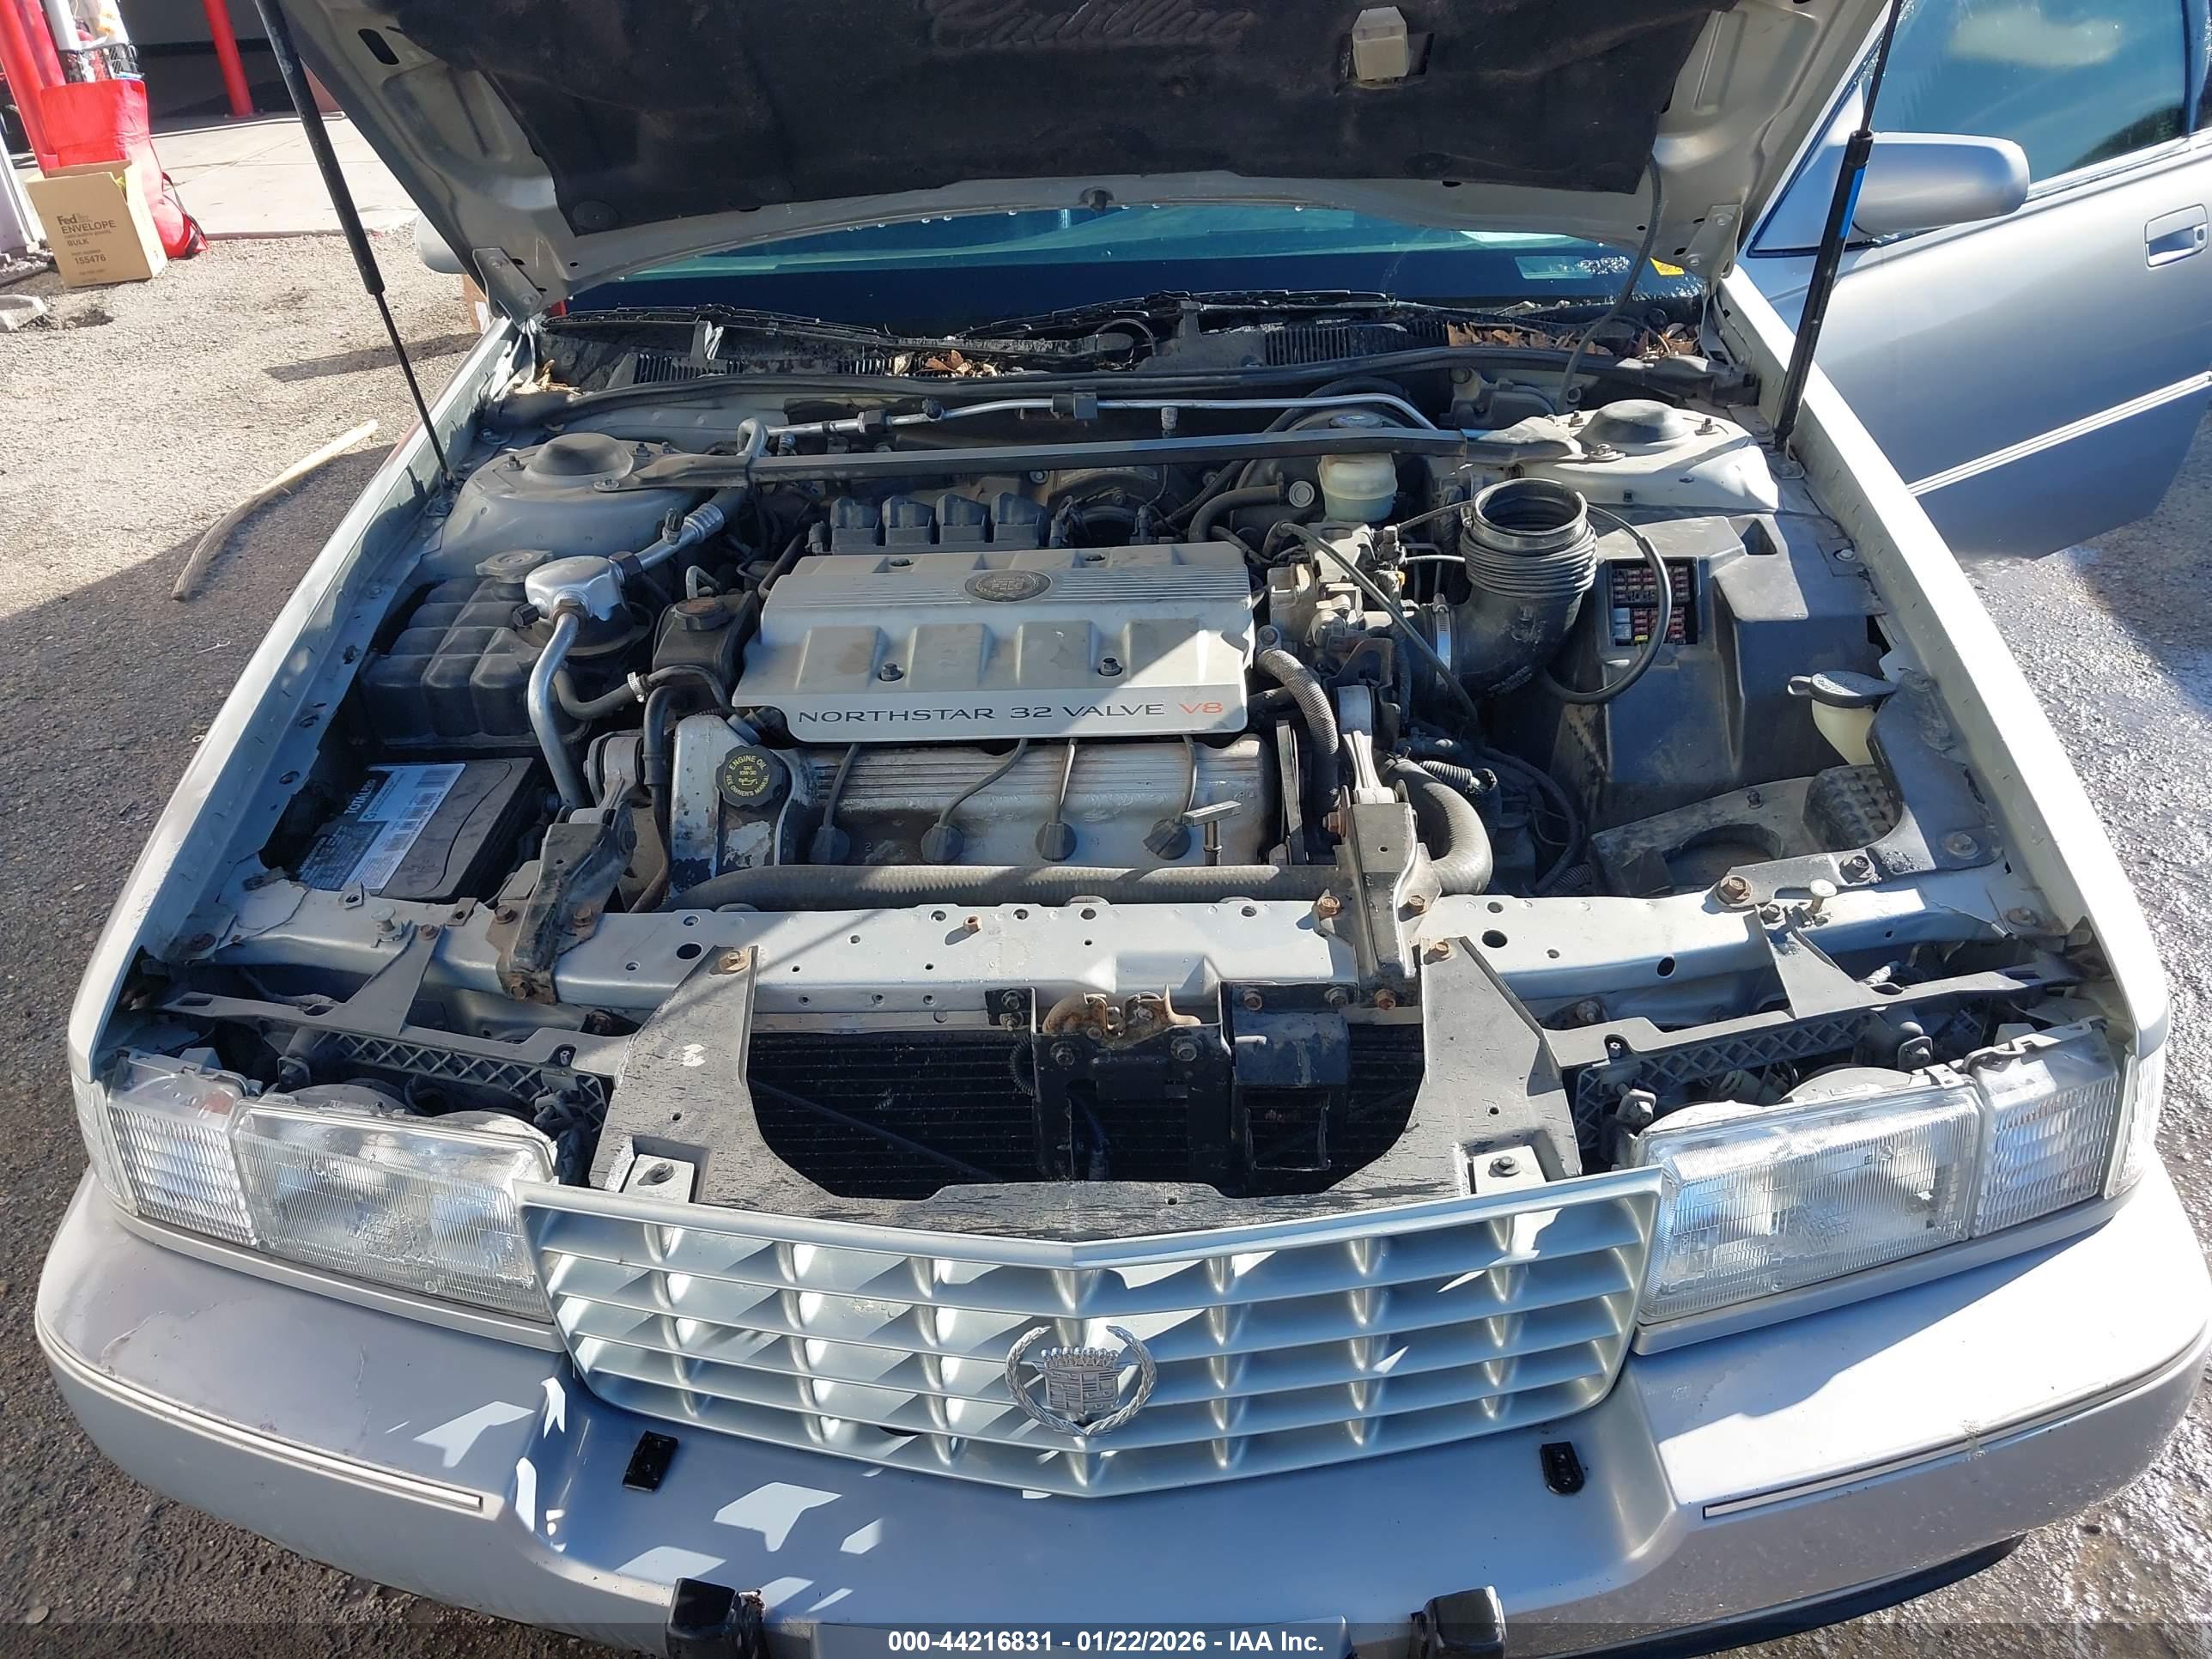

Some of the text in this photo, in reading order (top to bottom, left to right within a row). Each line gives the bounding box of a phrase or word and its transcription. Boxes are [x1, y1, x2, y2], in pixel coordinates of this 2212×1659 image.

[61, 220, 117, 234] ENVELOPE
[67, 238, 89, 247] BULK
[75, 253, 106, 264] 155476
[799, 702, 1224, 723] NORTHSTAR 32 VALVE V8
[728, 755, 768, 770] ENGINE OIL
[726, 774, 770, 797] SEE OWNER'S MANUAL
